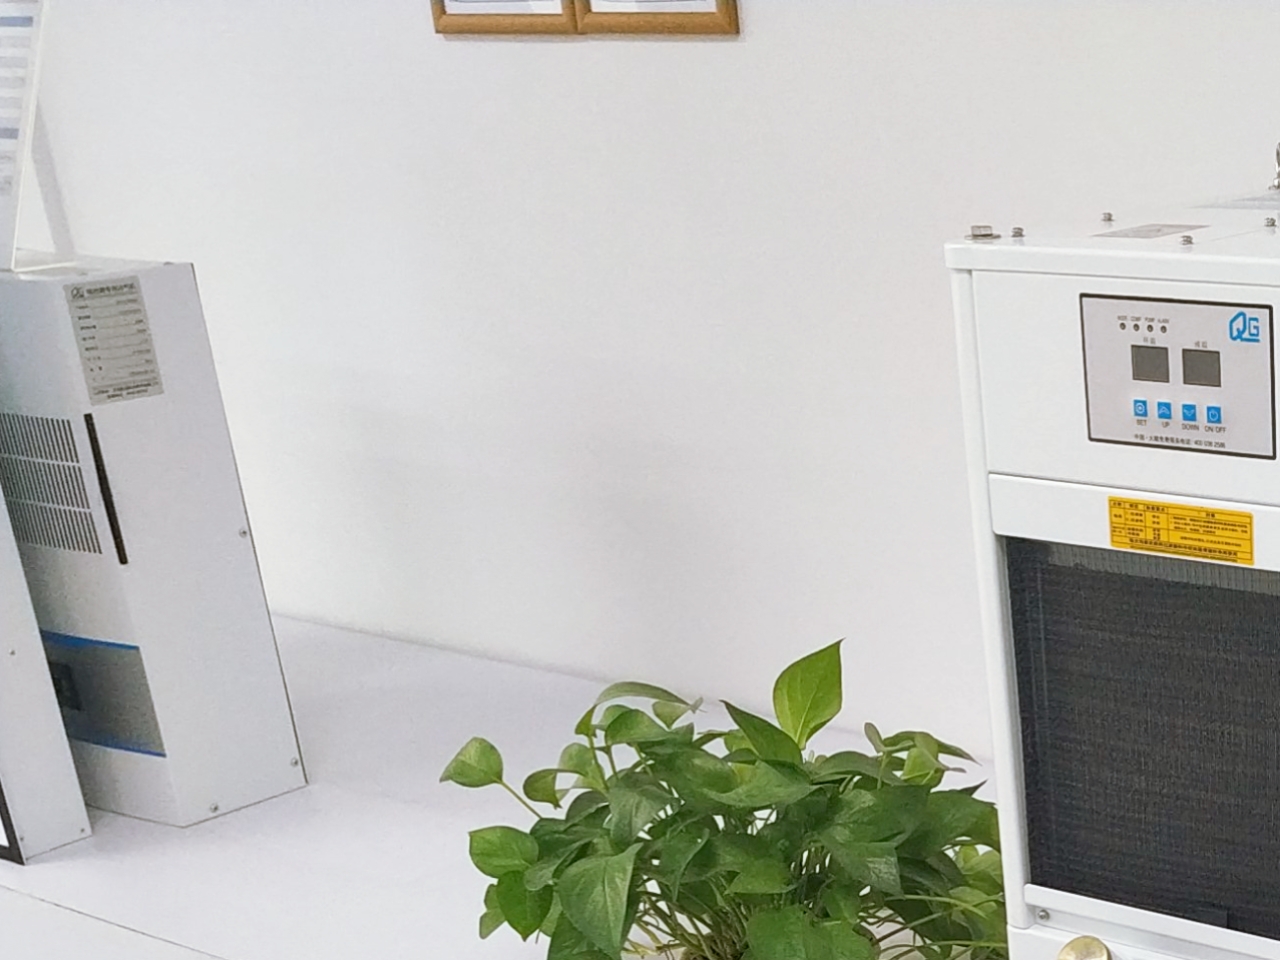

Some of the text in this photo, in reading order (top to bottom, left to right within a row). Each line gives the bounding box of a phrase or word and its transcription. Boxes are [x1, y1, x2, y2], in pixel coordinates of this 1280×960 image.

[1228, 311, 1261, 343] QG
[1162, 421, 1170, 429] UP
[1181, 423, 1199, 431] DOWN
